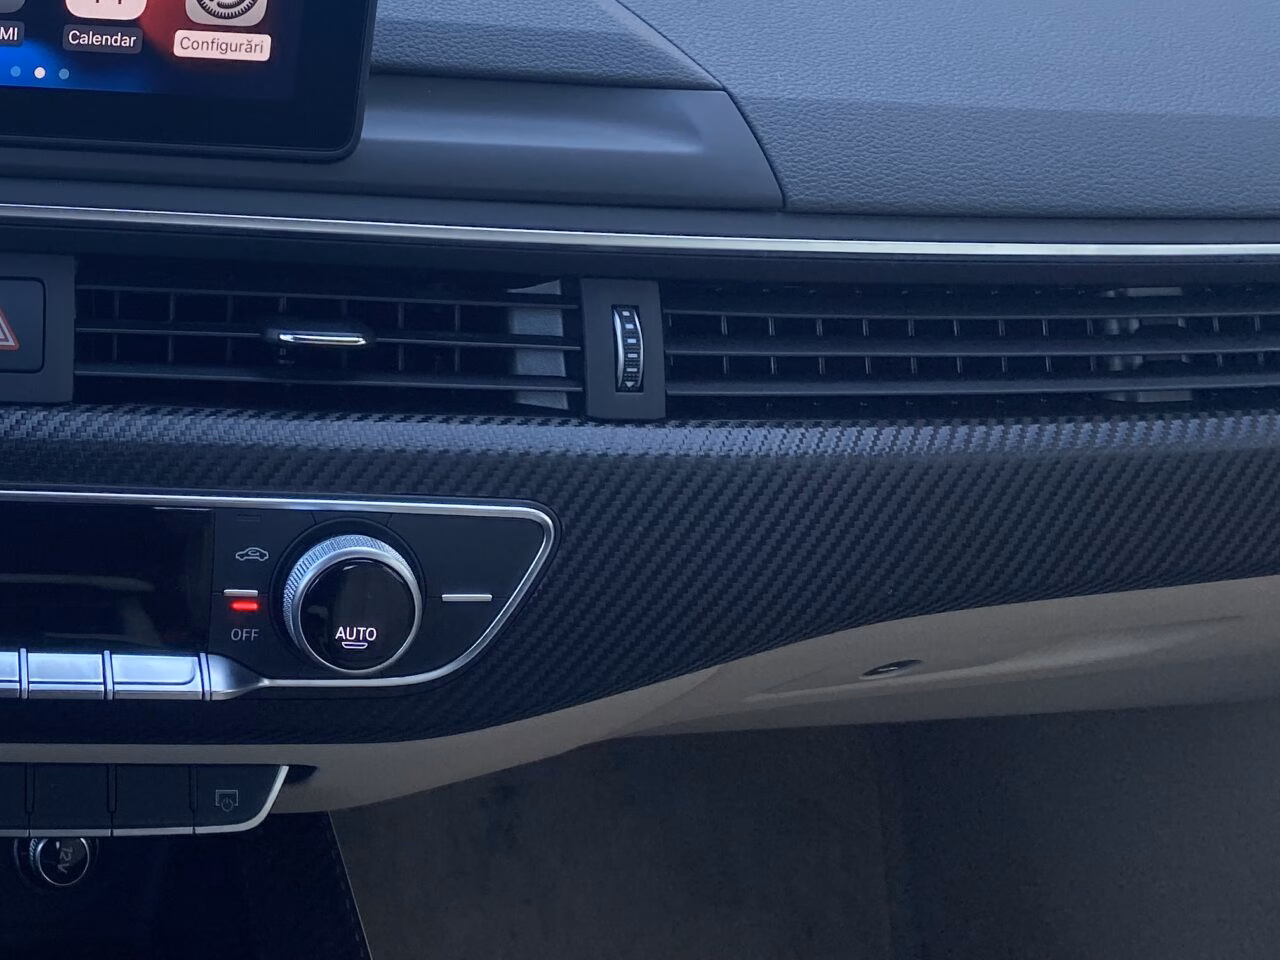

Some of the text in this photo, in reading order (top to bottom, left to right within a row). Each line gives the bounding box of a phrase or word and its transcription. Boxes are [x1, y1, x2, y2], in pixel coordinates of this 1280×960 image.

[67, 30, 137, 48] Calendar
[179, 35, 265, 55] Configurări
[230, 628, 260, 641] OFF
[335, 626, 377, 641] AUTO
